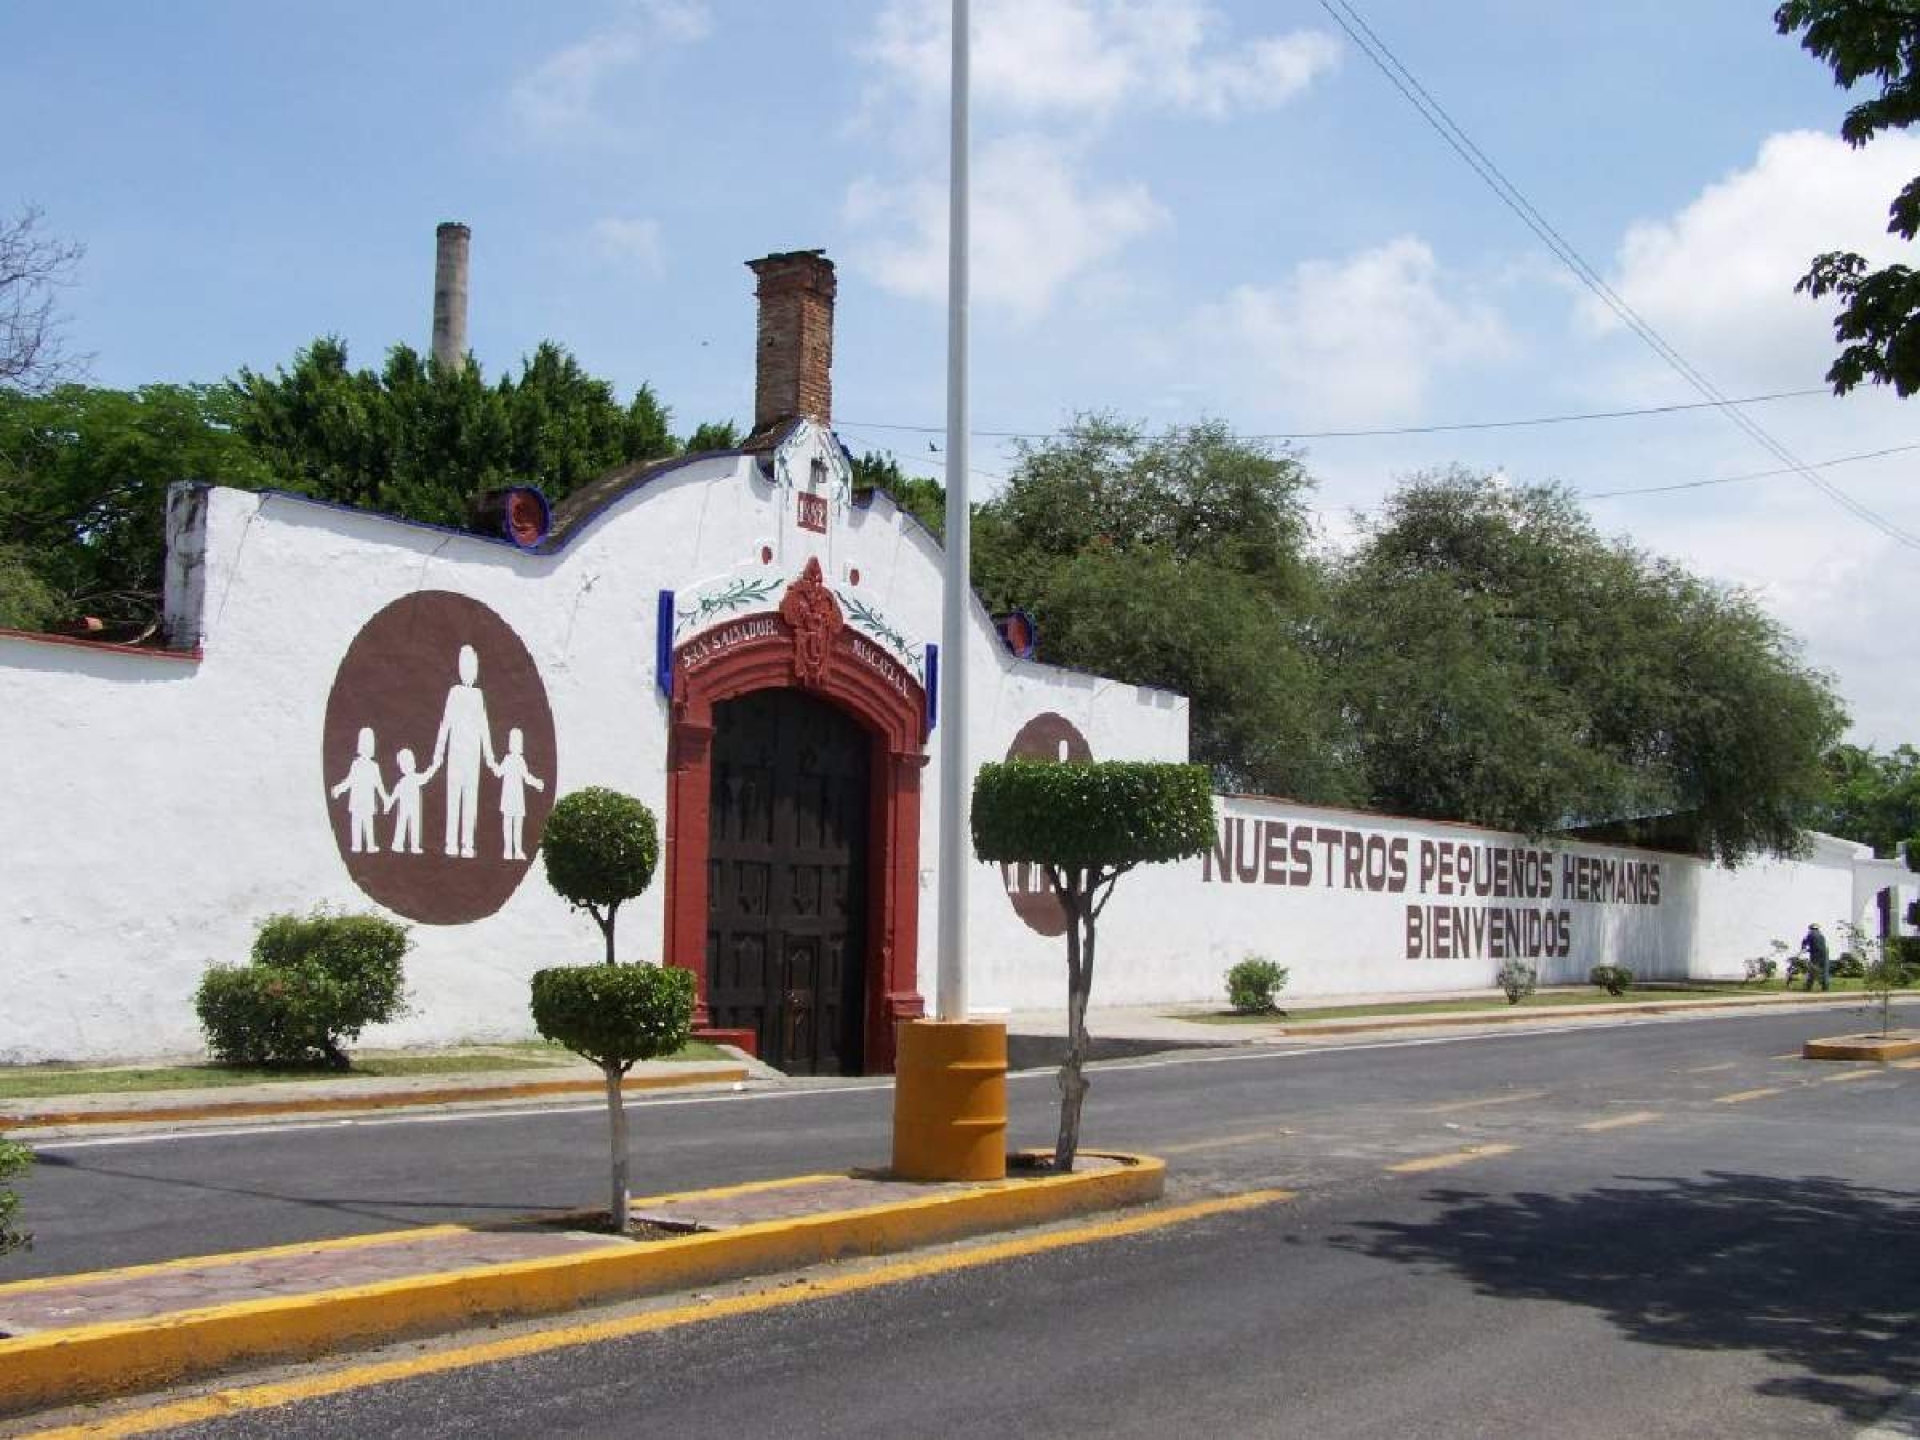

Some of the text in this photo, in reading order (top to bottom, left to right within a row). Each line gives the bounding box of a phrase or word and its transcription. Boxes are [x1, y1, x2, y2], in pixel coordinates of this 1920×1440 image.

[682, 641, 709, 668] SAN
[1202, 816, 1660, 906] NUESTROS PEQUEÑOS HERMANOS
[1406, 905, 1571, 960] BIENVENIDOS
